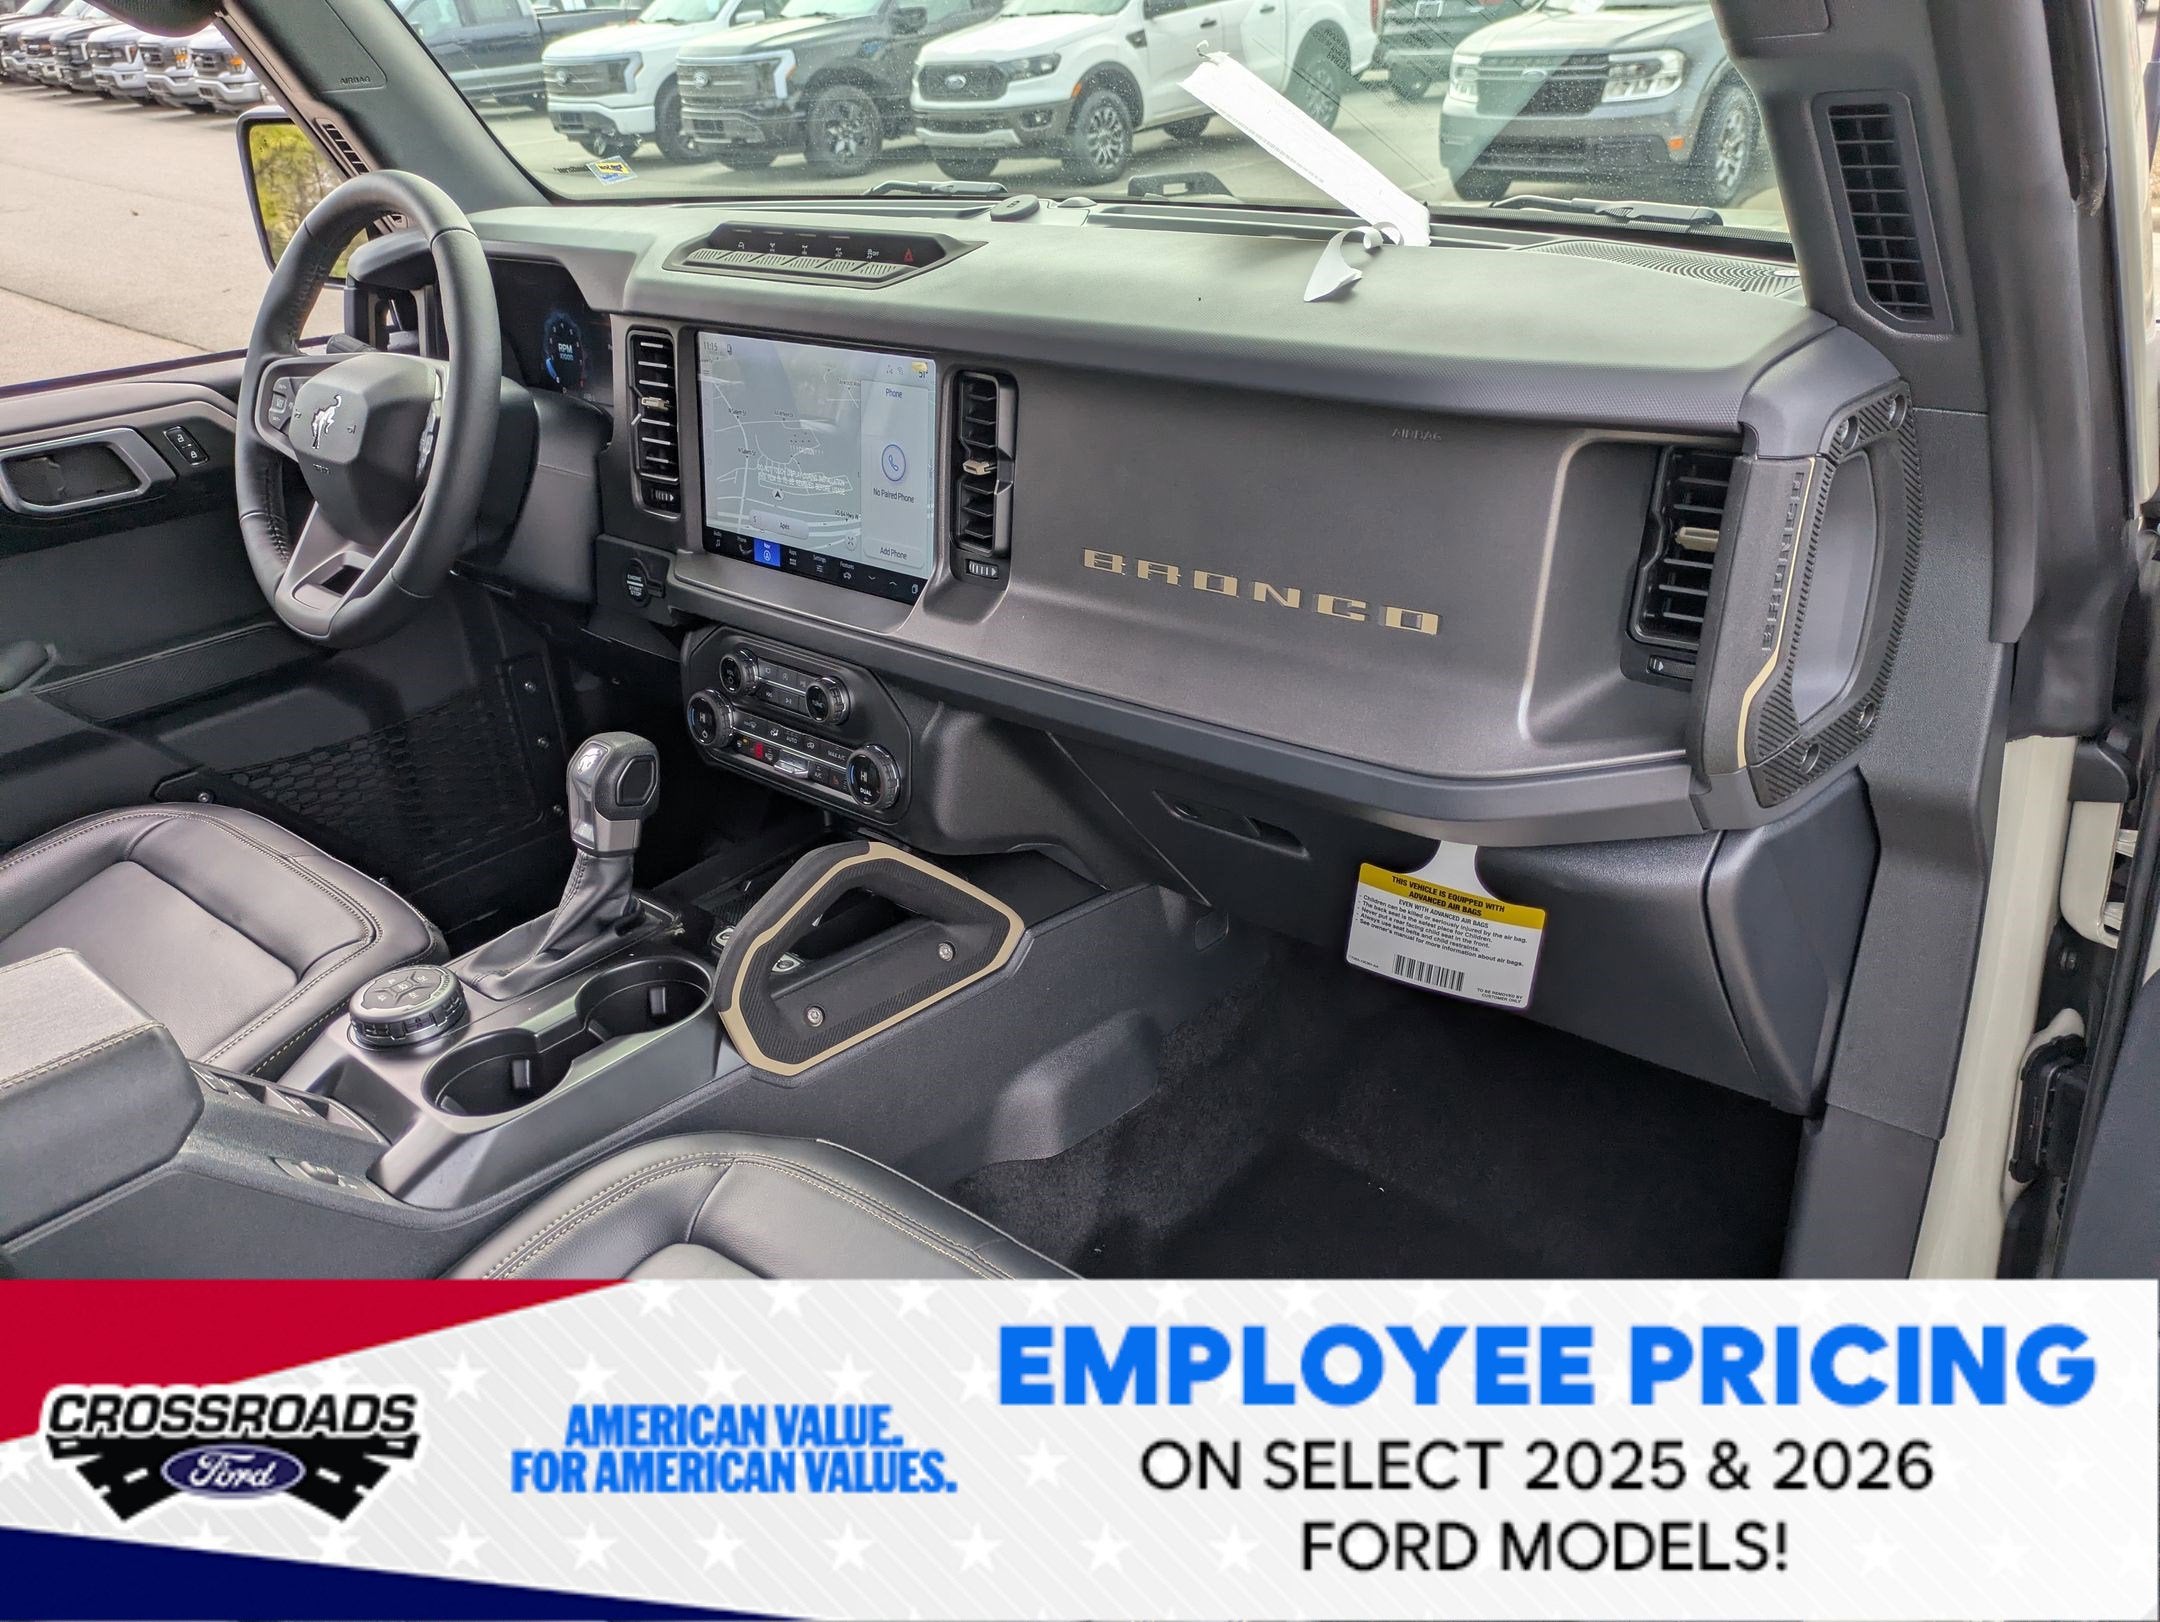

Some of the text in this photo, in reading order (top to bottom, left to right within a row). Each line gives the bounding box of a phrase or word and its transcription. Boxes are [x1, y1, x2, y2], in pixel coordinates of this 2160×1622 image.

[558, 343, 573, 353] RPM
[885, 387, 903, 399] Phone
[873, 487, 915, 503] No Paired Phone
[880, 547, 907, 560] Add Phone
[1084, 548, 1438, 634] BRONCO
[1392, 875, 1408, 886] THIS
[1409, 882, 1438, 896] VEHICLE
[1447, 892, 1484, 908] EQUIPPED
[1485, 902, 1505, 912] WITH
[1409, 890, 1482, 916] ADVANCED AIR BAGS
[1361, 907, 1377, 916] Never
[1378, 913, 1388, 921] put
[1406, 921, 1425, 932] facing
[1425, 928, 1440, 936] child
[1473, 940, 1490, 949] front.
[1362, 900, 1373, 908] The
[1373, 905, 1387, 913] back
[1388, 910, 1401, 918] seat
[1408, 915, 1418, 923] the
[1418, 919, 1437, 929] safest
[1437, 924, 1454, 934] place
[1464, 932, 1493, 943] Children.
[1363, 894, 1387, 907] Children
[1387, 903, 1399, 911] can
[1407, 910, 1424, 919] killed
[1431, 917, 1460, 930] seriously
[1460, 923, 1482, 934] injured
[1483, 928, 1492, 937] by
[1513, 936, 1528, 944] bag.
[1399, 899, 1489, 928] EVEN WITH ADVANCED AIR BAGS
[1360, 912, 1380, 924] Always
[1393, 924, 1405, 932] seat
[1405, 928, 1420, 936] belts
[1433, 936, 1449, 945] child
[1449, 940, 1480, 953] restraints.
[1360, 918, 1370, 926] See
[1370, 923, 1393, 934] owner's
[1393, 931, 1415, 941] manual
[1425, 940, 1441, 949] more
[1441, 945, 1477, 958] information
[1478, 953, 1496, 962] about
[1506, 959, 1524, 967] bags.
